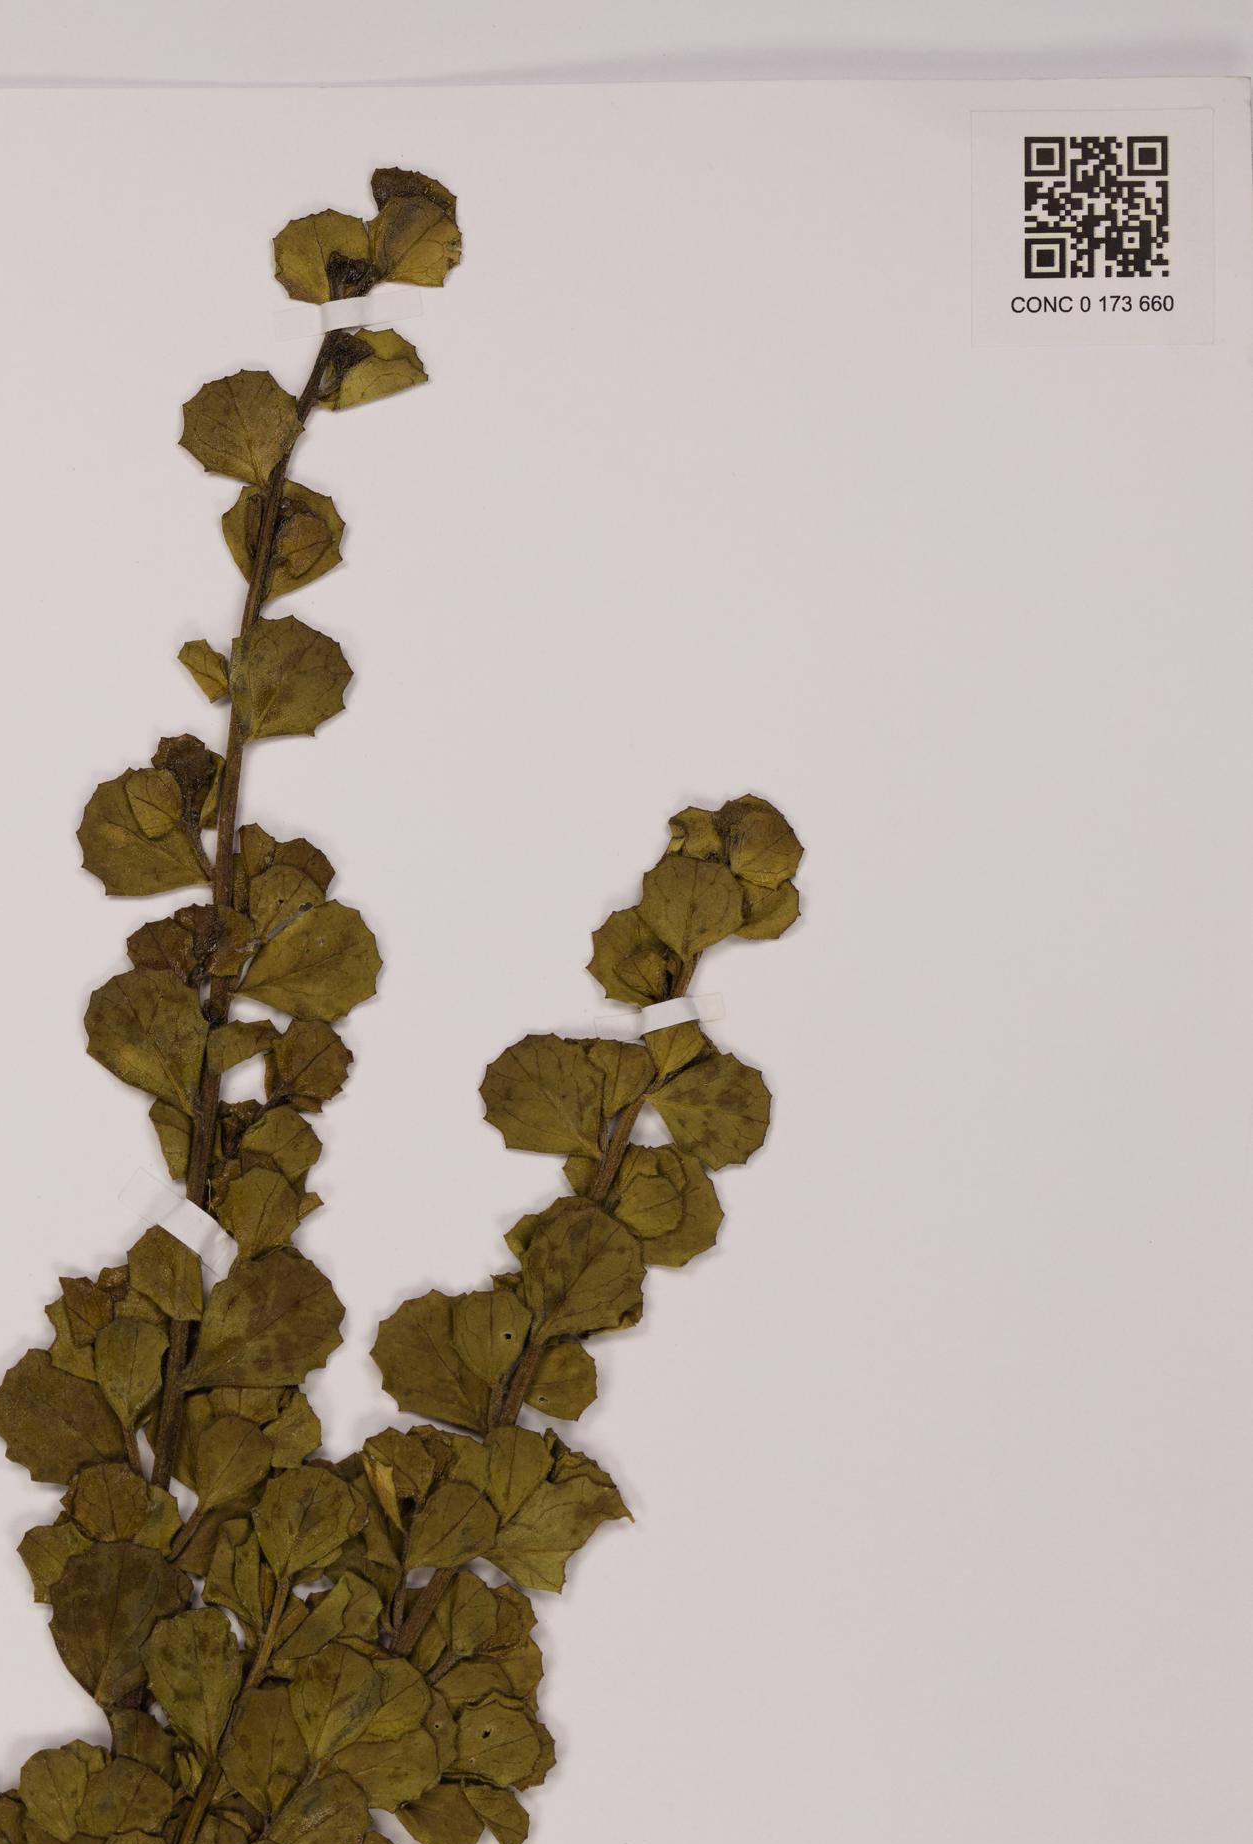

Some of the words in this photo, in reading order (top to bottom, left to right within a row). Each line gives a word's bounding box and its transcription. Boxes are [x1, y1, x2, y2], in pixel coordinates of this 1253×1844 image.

[1010, 295, 1073, 314] CONC
[1080, 295, 1091, 313] 0
[1098, 295, 1133, 313] 173
[1139, 295, 1175, 312] 660
